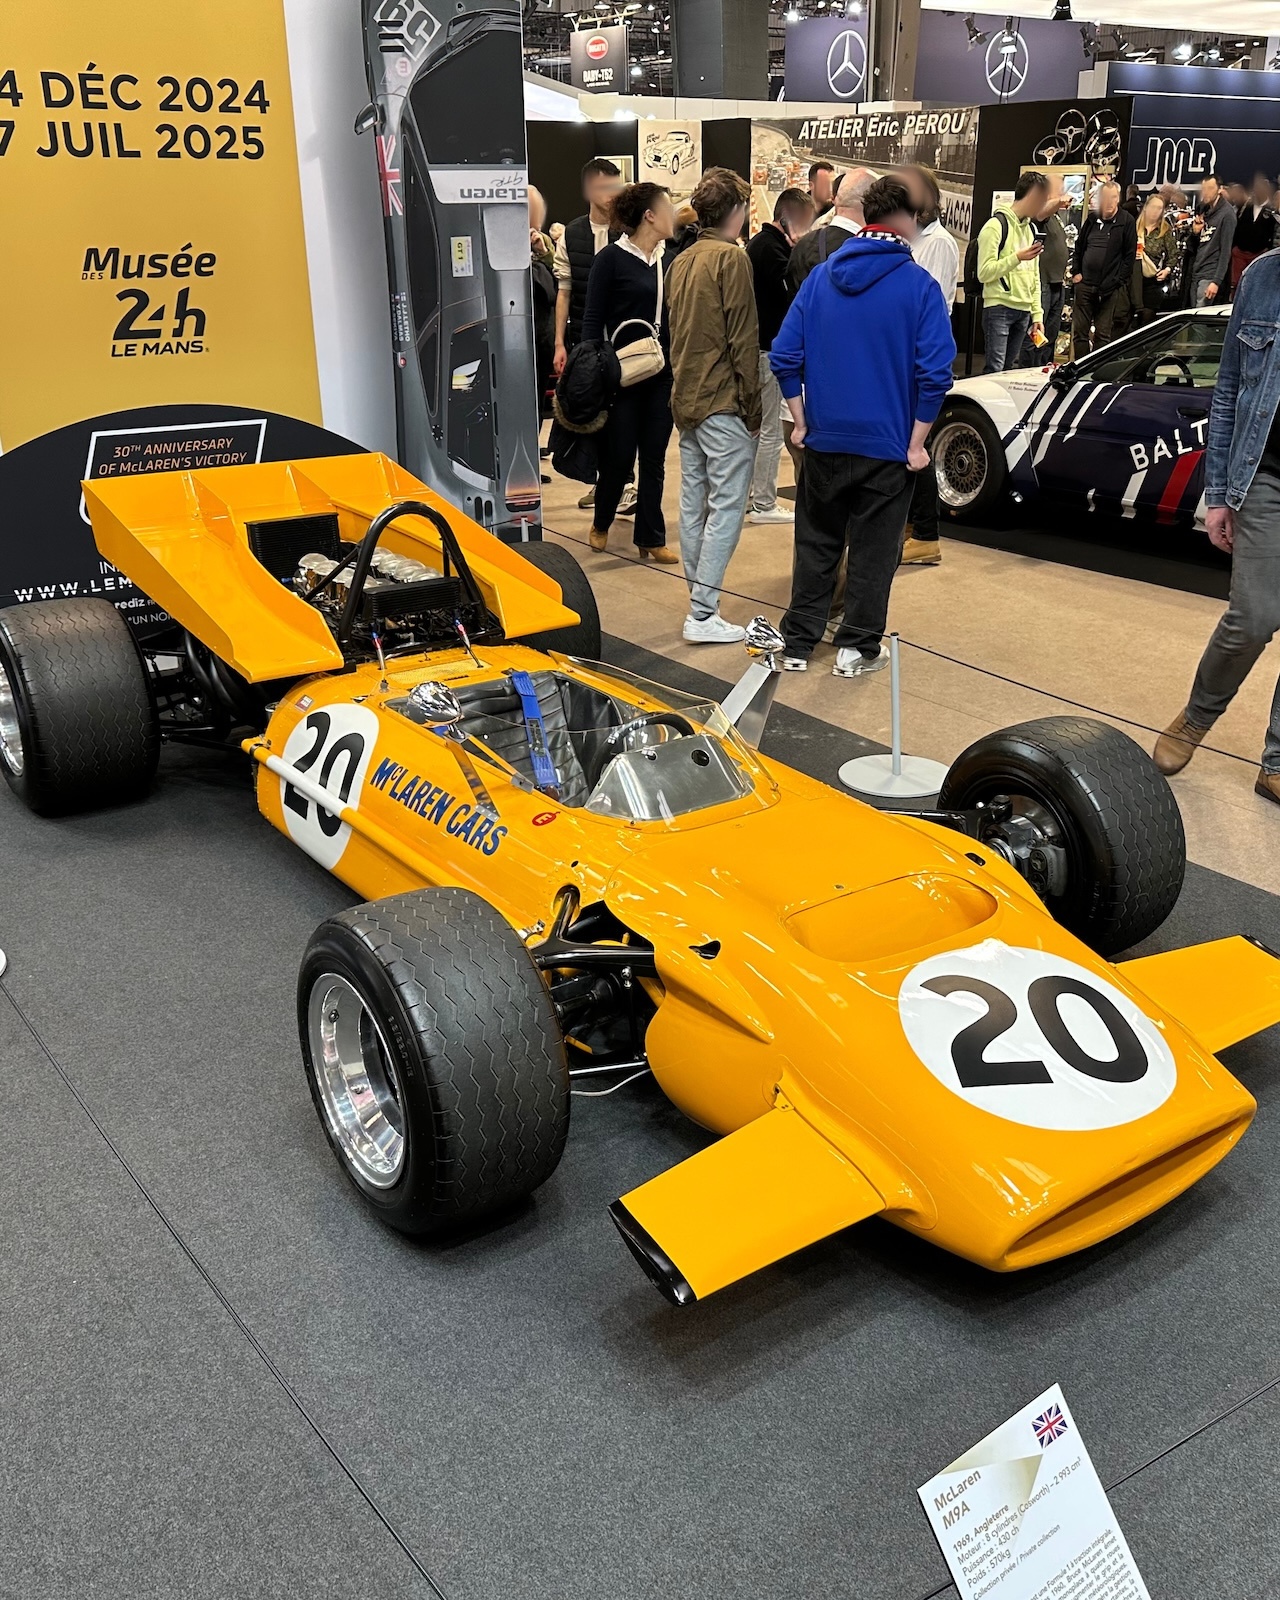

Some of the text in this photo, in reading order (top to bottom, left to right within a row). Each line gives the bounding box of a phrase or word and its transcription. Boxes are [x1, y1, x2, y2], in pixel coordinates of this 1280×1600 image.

[40, 62, 142, 110] DÉC
[157, 76, 270, 114] 2024
[37, 121, 141, 158] JUIL
[155, 123, 265, 160] 2025
[798, 118, 864, 140] ATELIER
[903, 112, 966, 136] PEROU
[81, 272, 104, 280] DES
[83, 242, 217, 279] Musée
[111, 343, 137, 357] LE
[98, 461, 116, 476] OF
[195, 451, 248, 467] VICTORY
[143, 437, 234, 456] ANNIVERSARY
[99, 561, 120, 574] IN
[14, 576, 133, 602] WWW.LEM
[284, 711, 365, 838] 20
[448, 804, 508, 856] CARS
[919, 974, 1149, 1089] 20
[933, 1470, 982, 1512] McLaren
[942, 1500, 971, 1530] M9A
[952, 1504, 1009, 1553] 1969, Angleterre
[957, 1541, 981, 1566] Moteur
[991, 1511, 1018, 1538] cylindres
[1053, 1475, 1060, 1486] 2
[1058, 1466, 1071, 1481] 993
[962, 1547, 995, 1577] Puissance
[998, 1531, 1011, 1546] 430
[1010, 1525, 1020, 1537] ch
[966, 1568, 987, 1589] Poids
[989, 1548, 1012, 1570] 570kg
[973, 1576, 1000, 1600] Collection
[1037, 1524, 1061, 1548] collection
